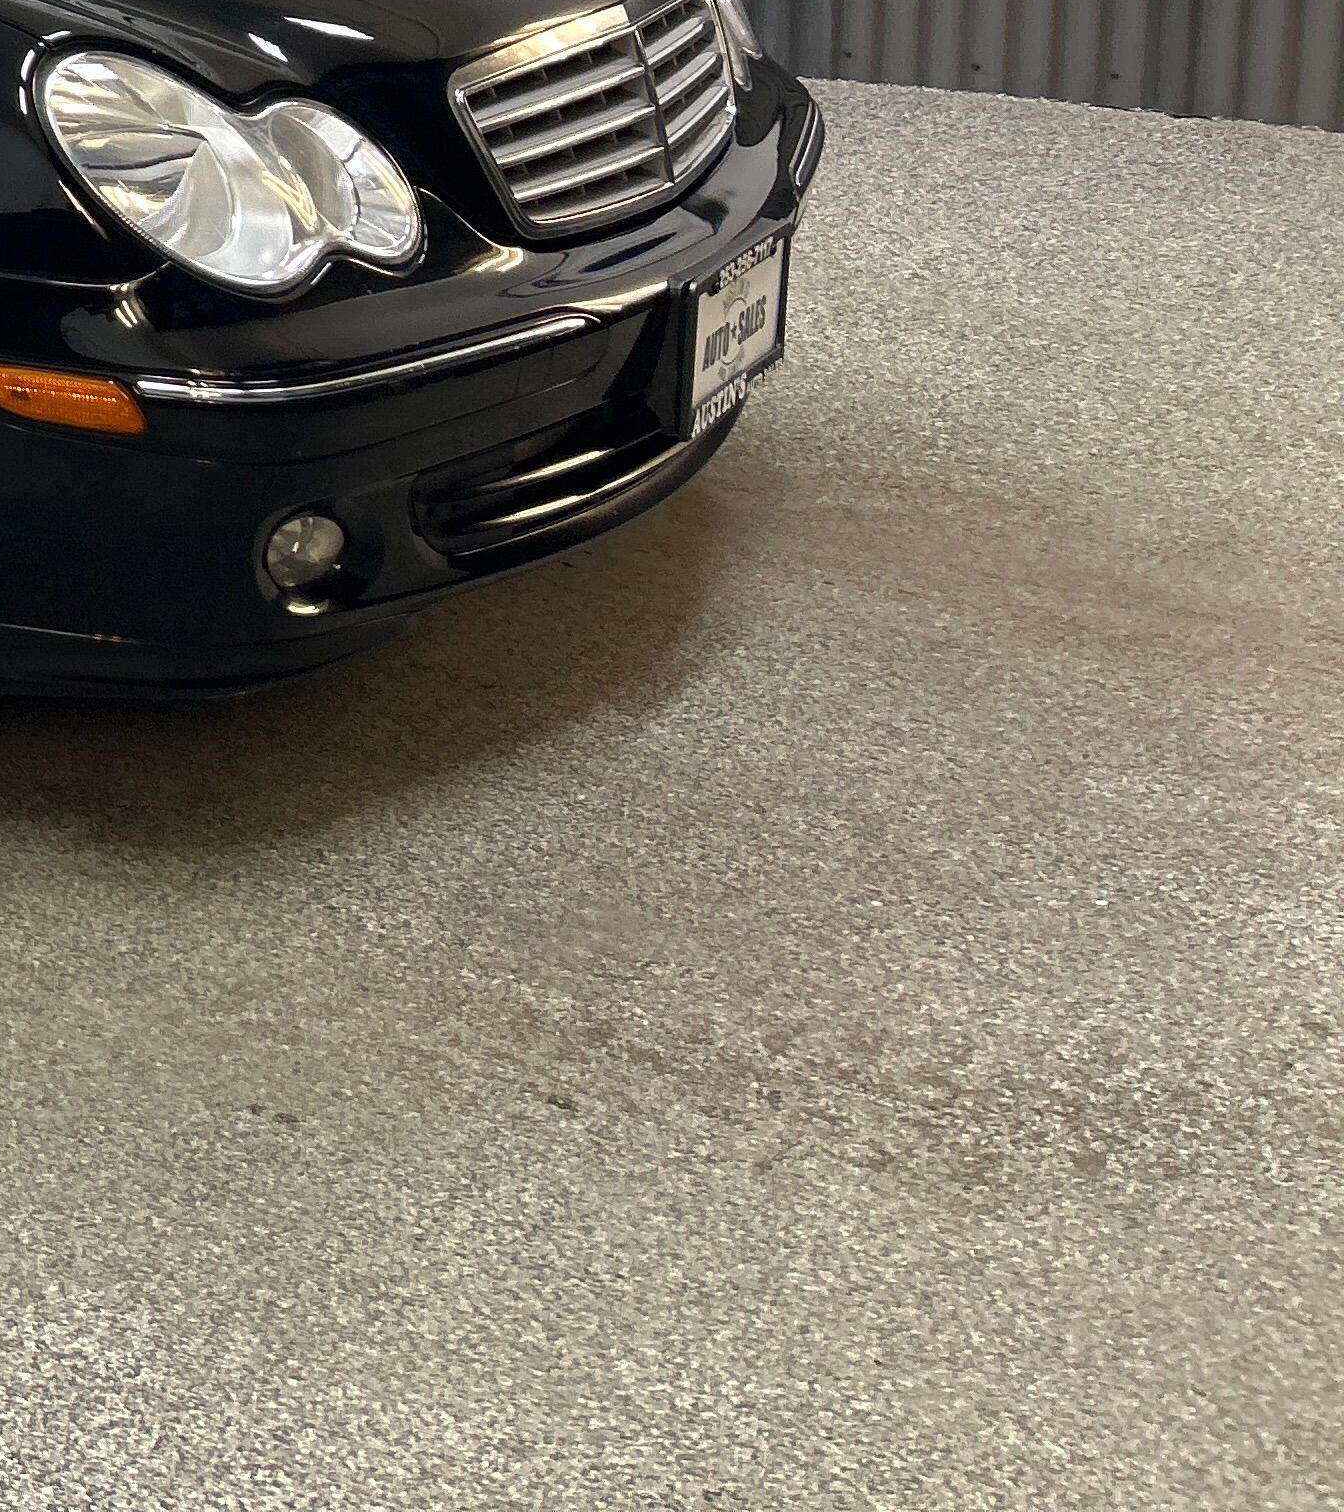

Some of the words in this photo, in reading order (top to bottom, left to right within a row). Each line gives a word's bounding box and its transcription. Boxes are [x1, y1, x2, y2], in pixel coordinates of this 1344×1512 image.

[702, 321, 730, 372] AUTO
[738, 295, 767, 345] SALES
[691, 372, 748, 439] AUSTIN'S
